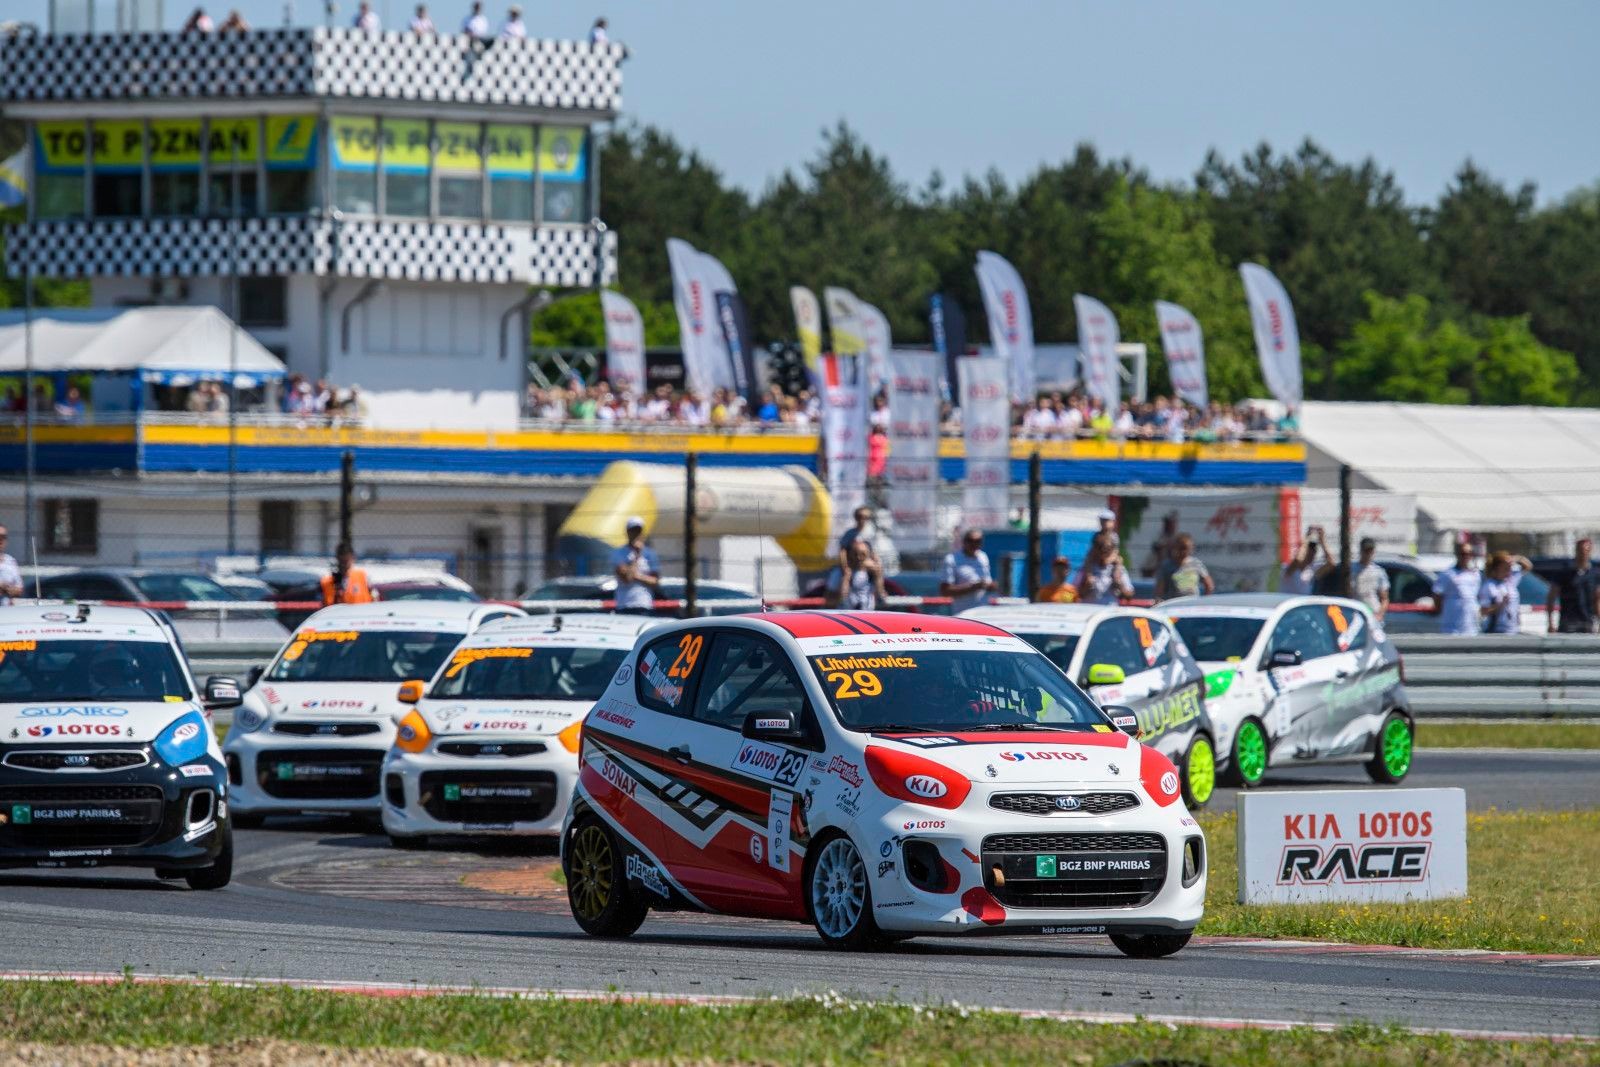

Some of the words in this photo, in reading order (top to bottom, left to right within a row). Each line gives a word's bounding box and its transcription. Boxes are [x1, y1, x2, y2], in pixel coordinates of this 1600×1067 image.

[47, 128, 109, 156] TOR
[340, 126, 394, 150] TOR
[668, 634, 703, 679] 29
[816, 655, 917, 672] Litwinowicz
[827, 669, 883, 700] 29
[321, 700, 364, 708] LOTOS
[57, 724, 120, 736] LOTOS
[483, 721, 528, 730] LOTOS
[751, 748, 780, 771] LOTOS
[1025, 751, 1089, 761] LOTOS
[775, 753, 804, 784] 29
[602, 758, 638, 798] SONAX
[910, 777, 940, 795] KIA
[1162, 774, 1177, 792] KIA
[1060, 798, 1078, 808] KIA
[57, 809, 78, 818] BNP
[80, 809, 121, 818] PARIBAS
[1284, 813, 1342, 840] KIA
[1359, 810, 1433, 838] LOTOS
[1084, 861, 1106, 870] BNP
[1108, 860, 1151, 870] PARIBAS
[1280, 846, 1427, 881] RACE
